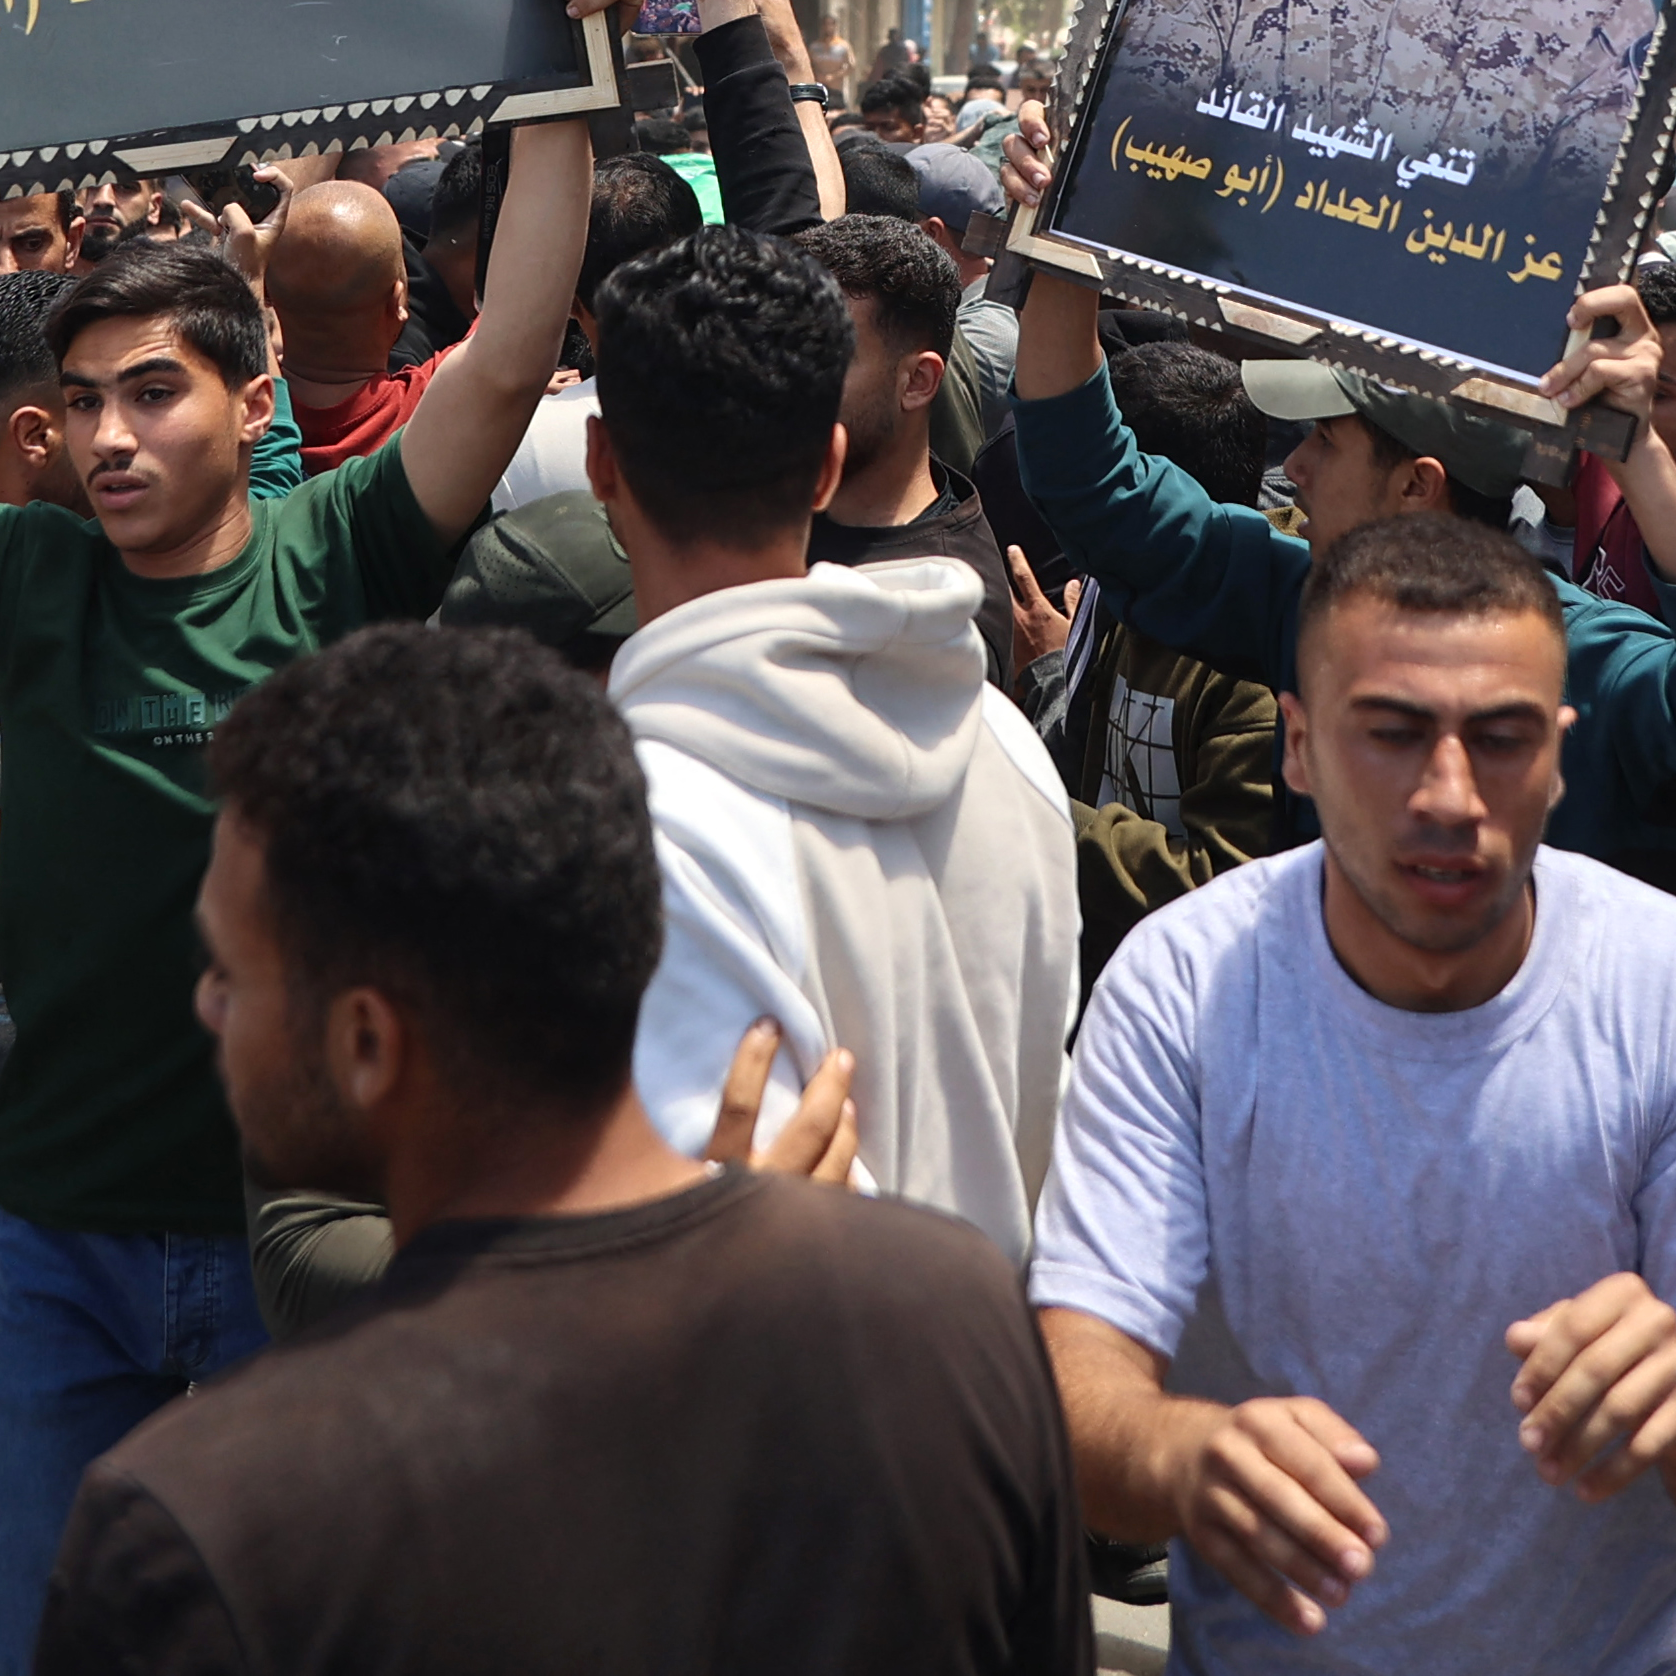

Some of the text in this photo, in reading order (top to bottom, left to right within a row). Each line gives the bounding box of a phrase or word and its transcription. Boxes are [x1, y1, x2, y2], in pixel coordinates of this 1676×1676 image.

[1195, 84, 1477, 189] تنعي الشهيد القائد
[486, 164, 498, 193] EOS
[485, 195, 496, 211] R6
[1110, 116, 1564, 284] عز الدين الحداد (أبو صهيب)
[141, 692, 206, 730] THE
[152, 732, 173, 746] ON
[174, 731, 204, 744] THE
